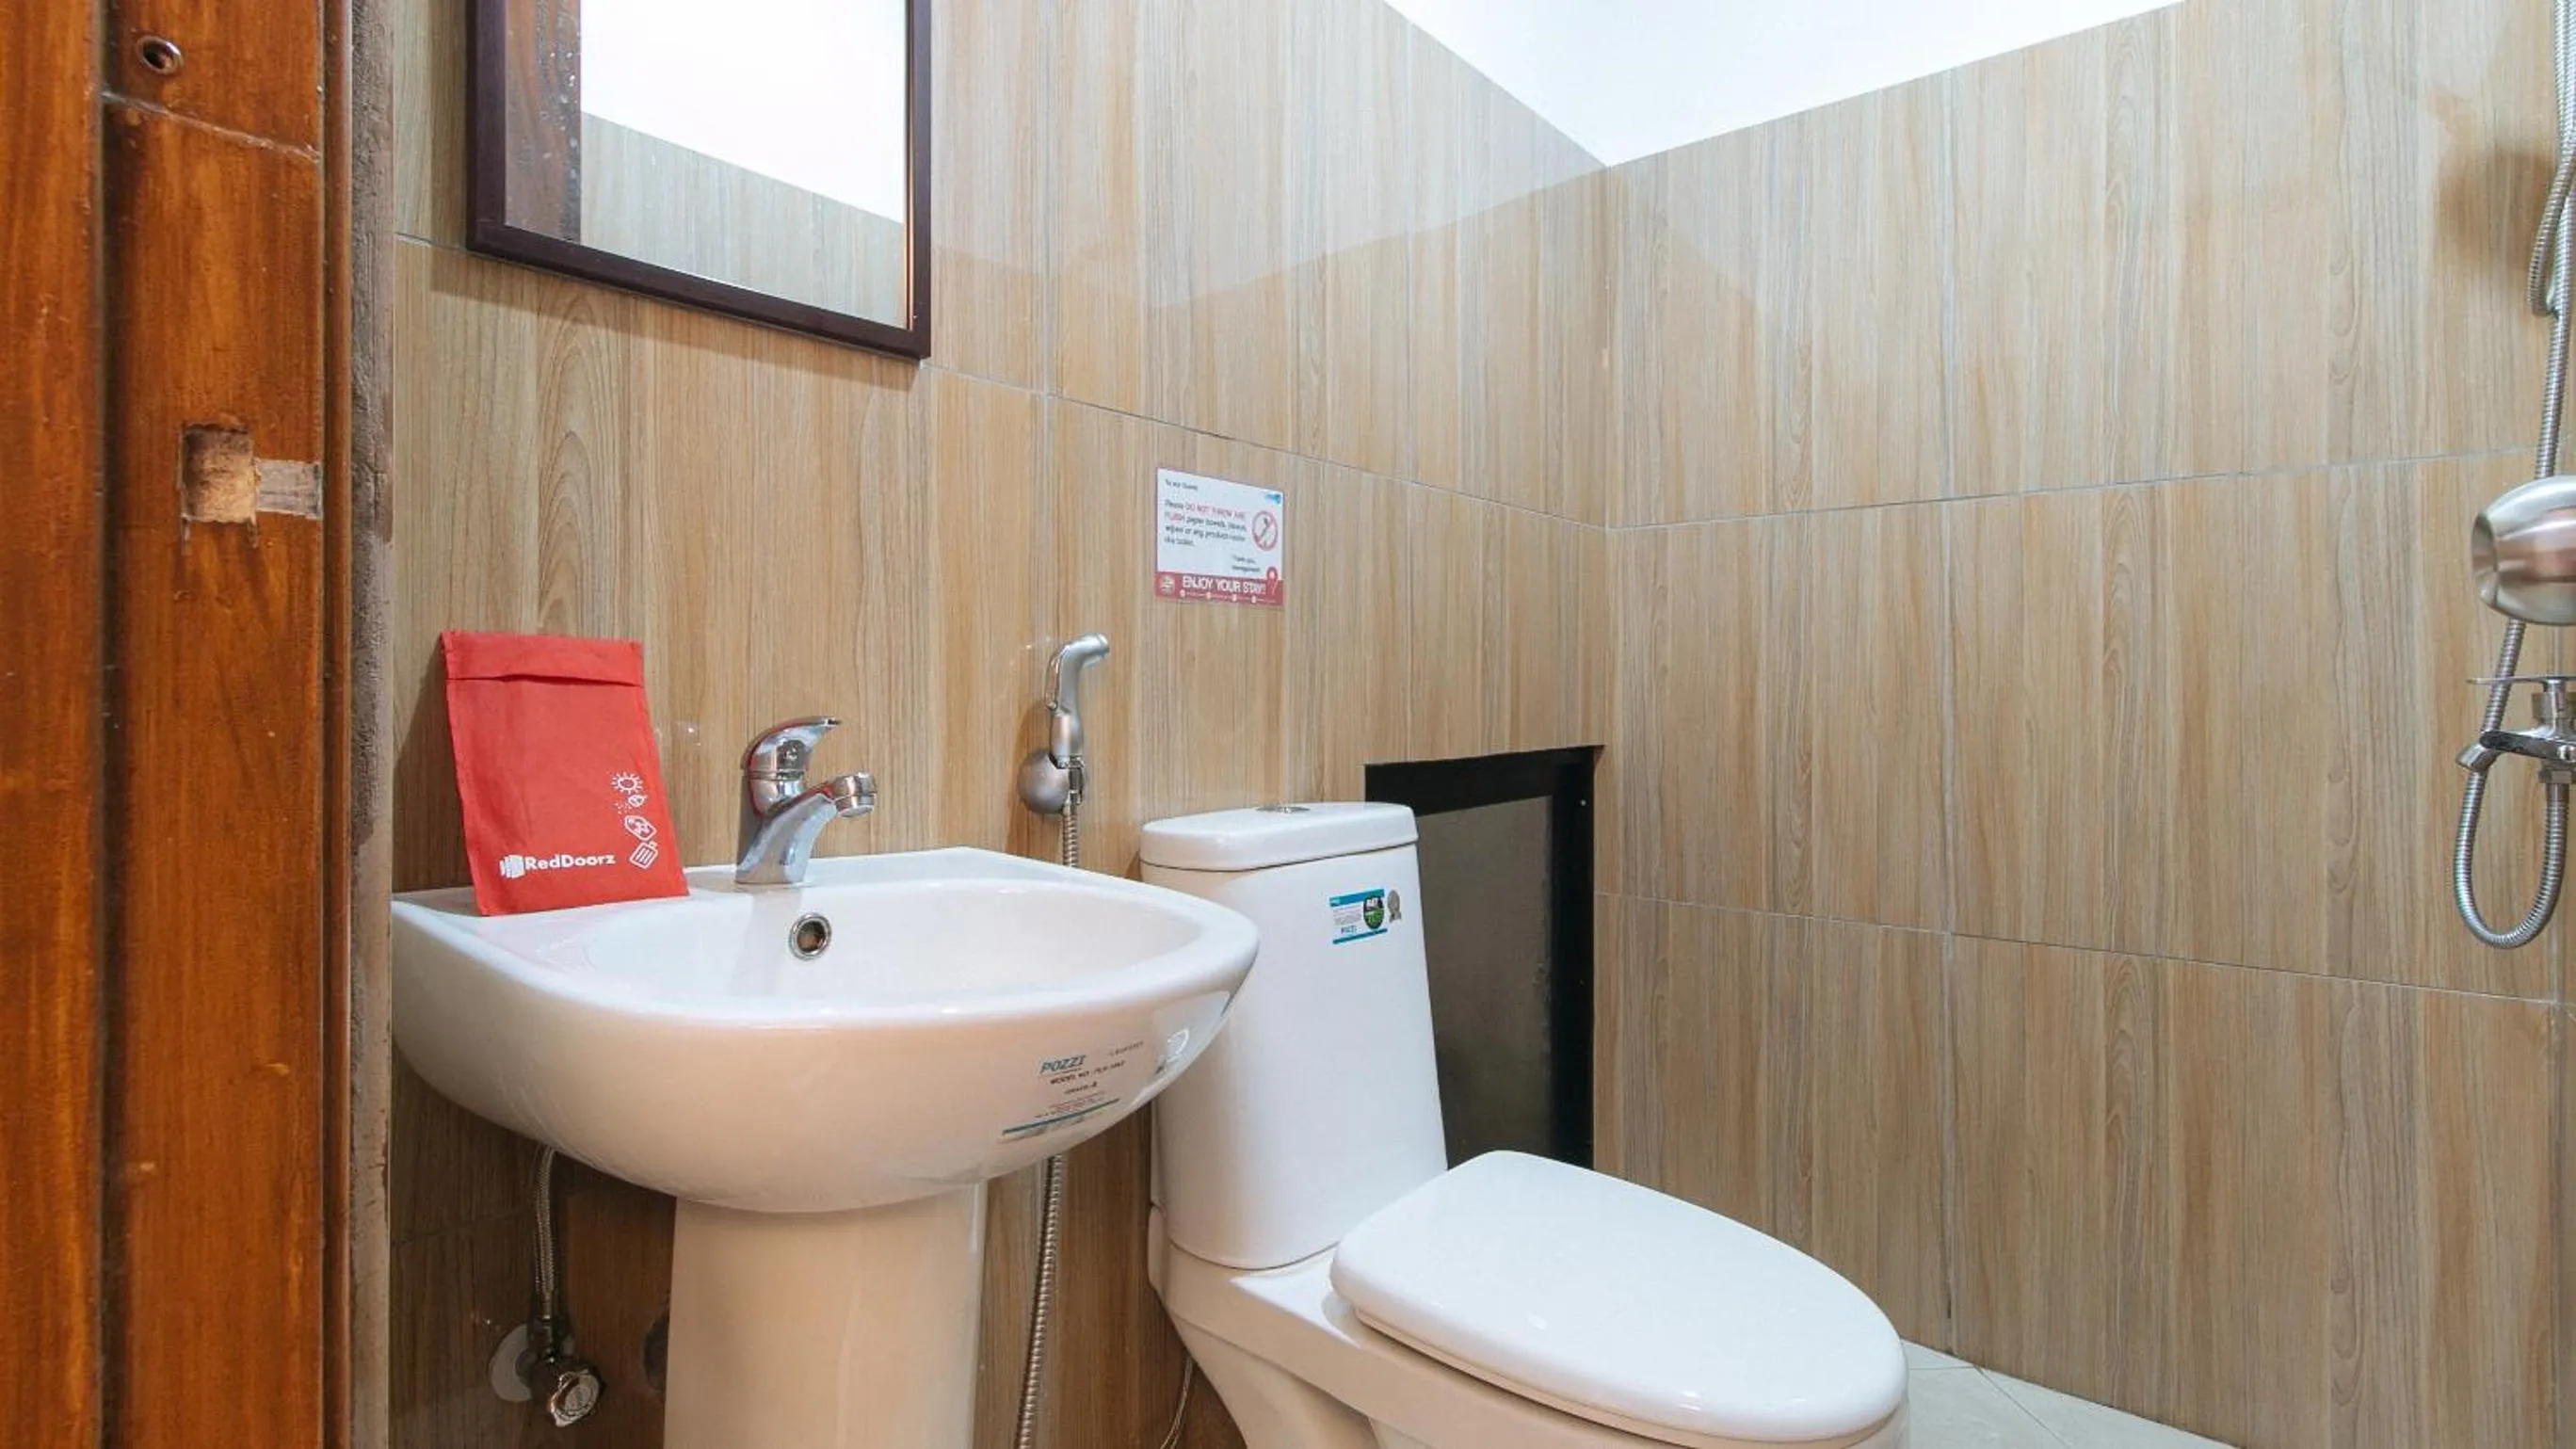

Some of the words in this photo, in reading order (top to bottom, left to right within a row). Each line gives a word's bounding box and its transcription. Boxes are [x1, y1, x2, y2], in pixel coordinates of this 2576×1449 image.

[1185, 502, 1196, 510] DO
[1197, 504, 1210, 512] NOT
[1182, 575, 1214, 590] ENJOY
[1216, 578, 1241, 593] YOUR
[524, 854, 616, 870] RedDoorz
[1039, 1054, 1087, 1073] POZZI
